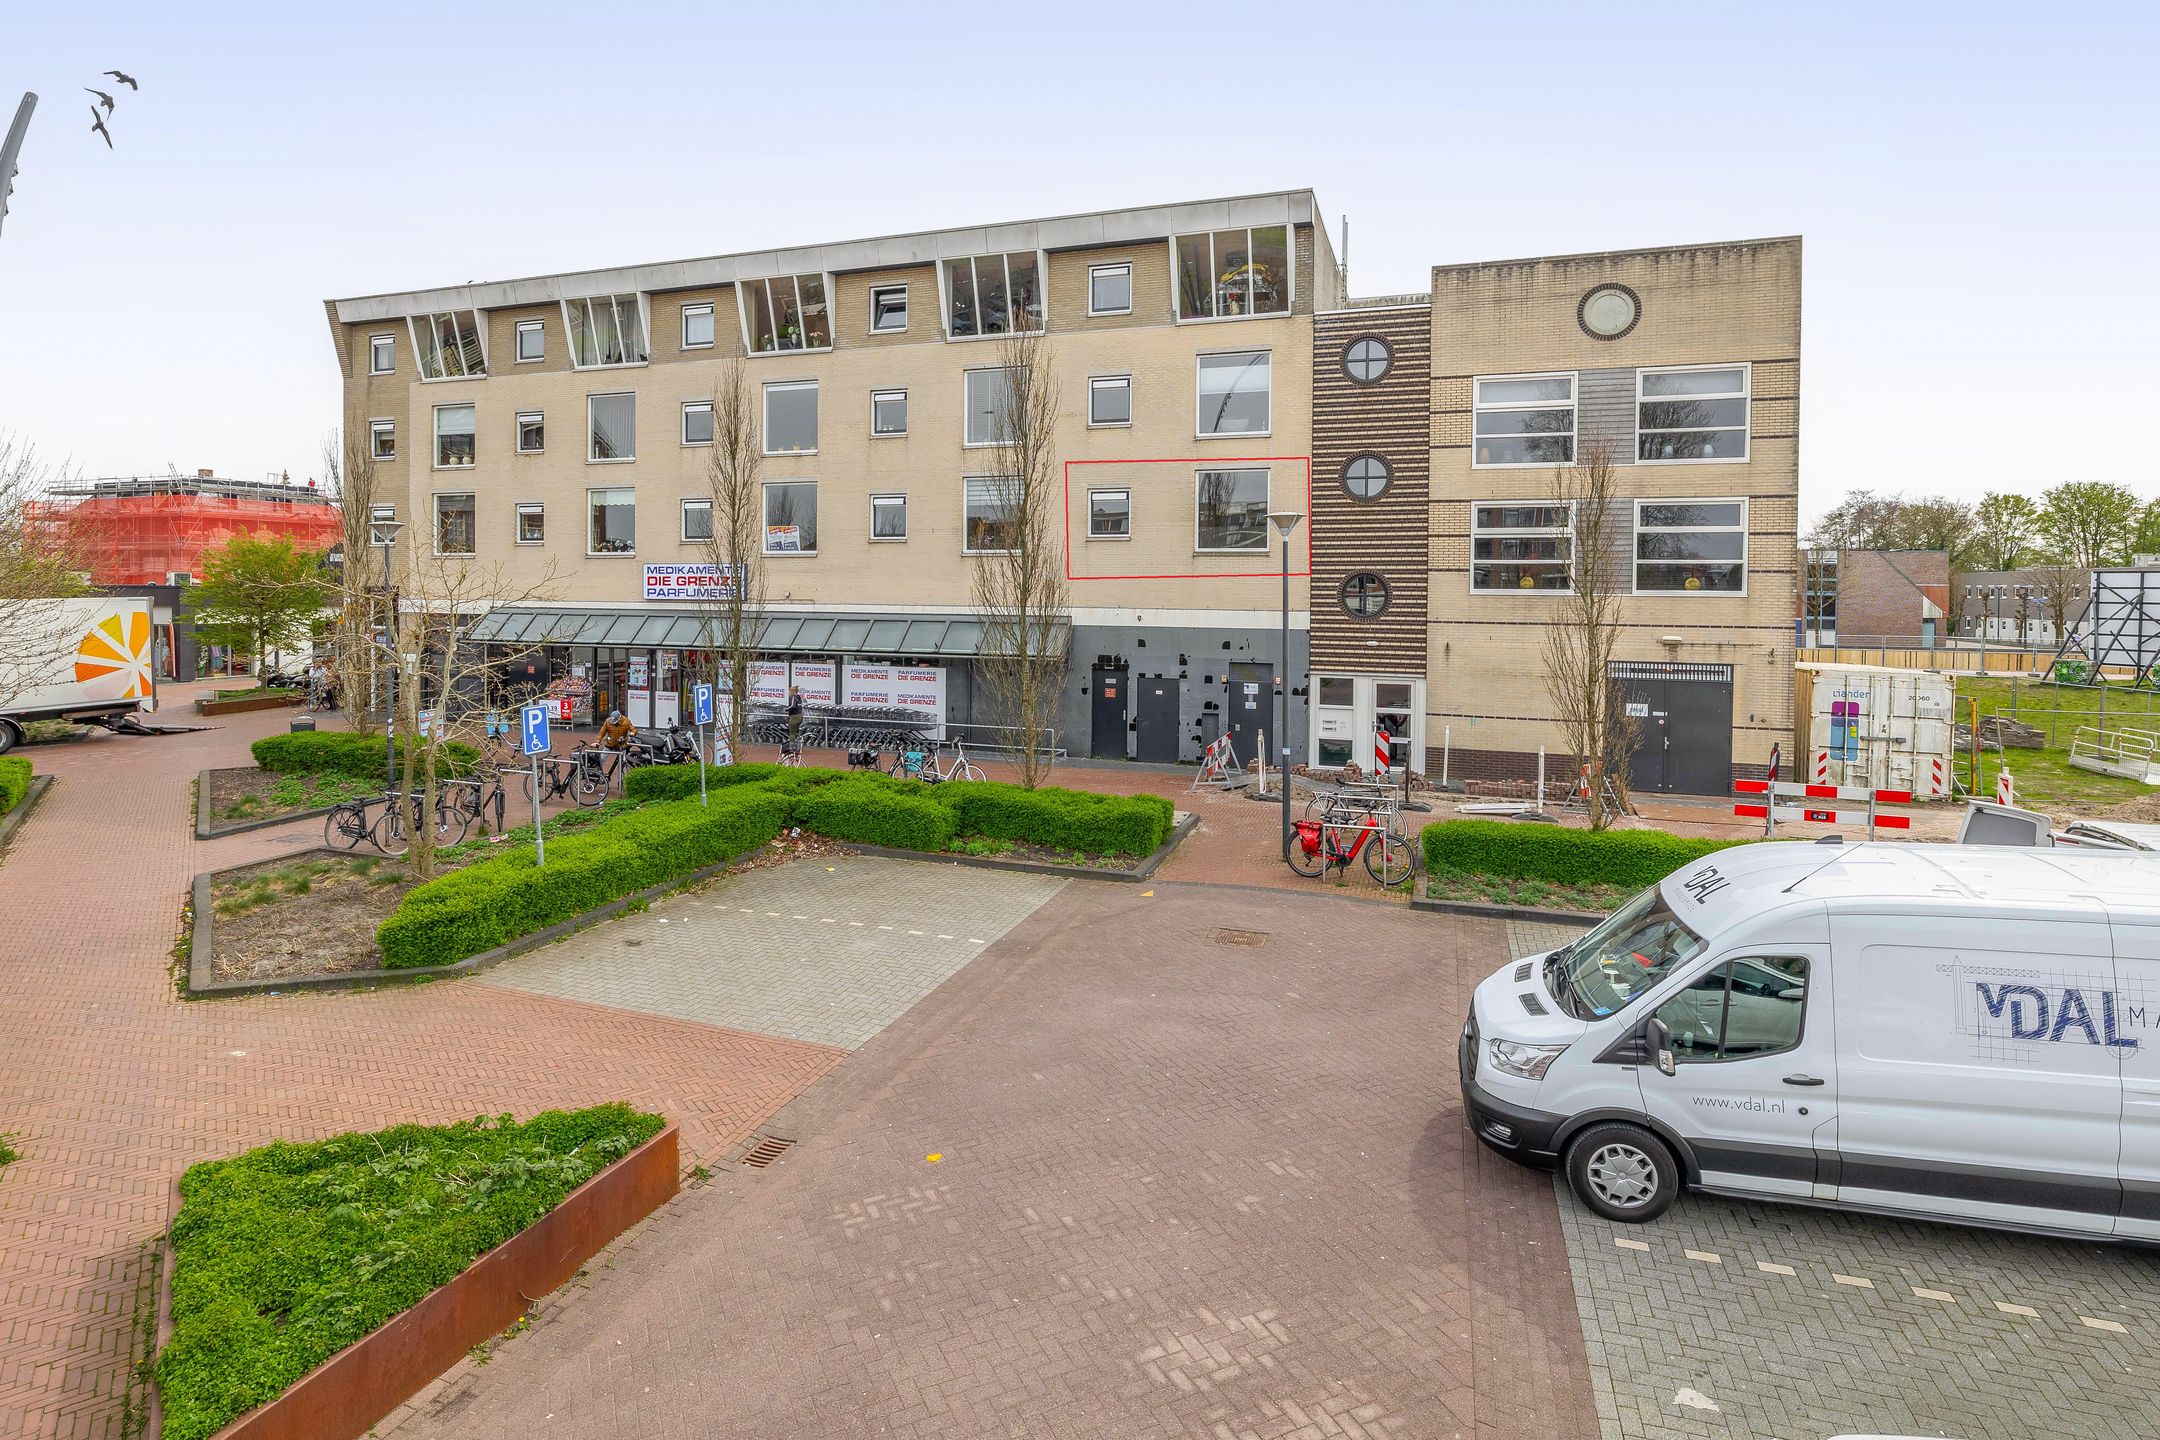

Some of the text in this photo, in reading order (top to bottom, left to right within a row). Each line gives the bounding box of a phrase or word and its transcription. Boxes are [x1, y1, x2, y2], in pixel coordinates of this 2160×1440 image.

[647, 576, 672, 586] DIE
[698, 688, 708, 708] P
[528, 709, 543, 734] P
[1692, 1096, 1785, 1114] www.vdal.nl
